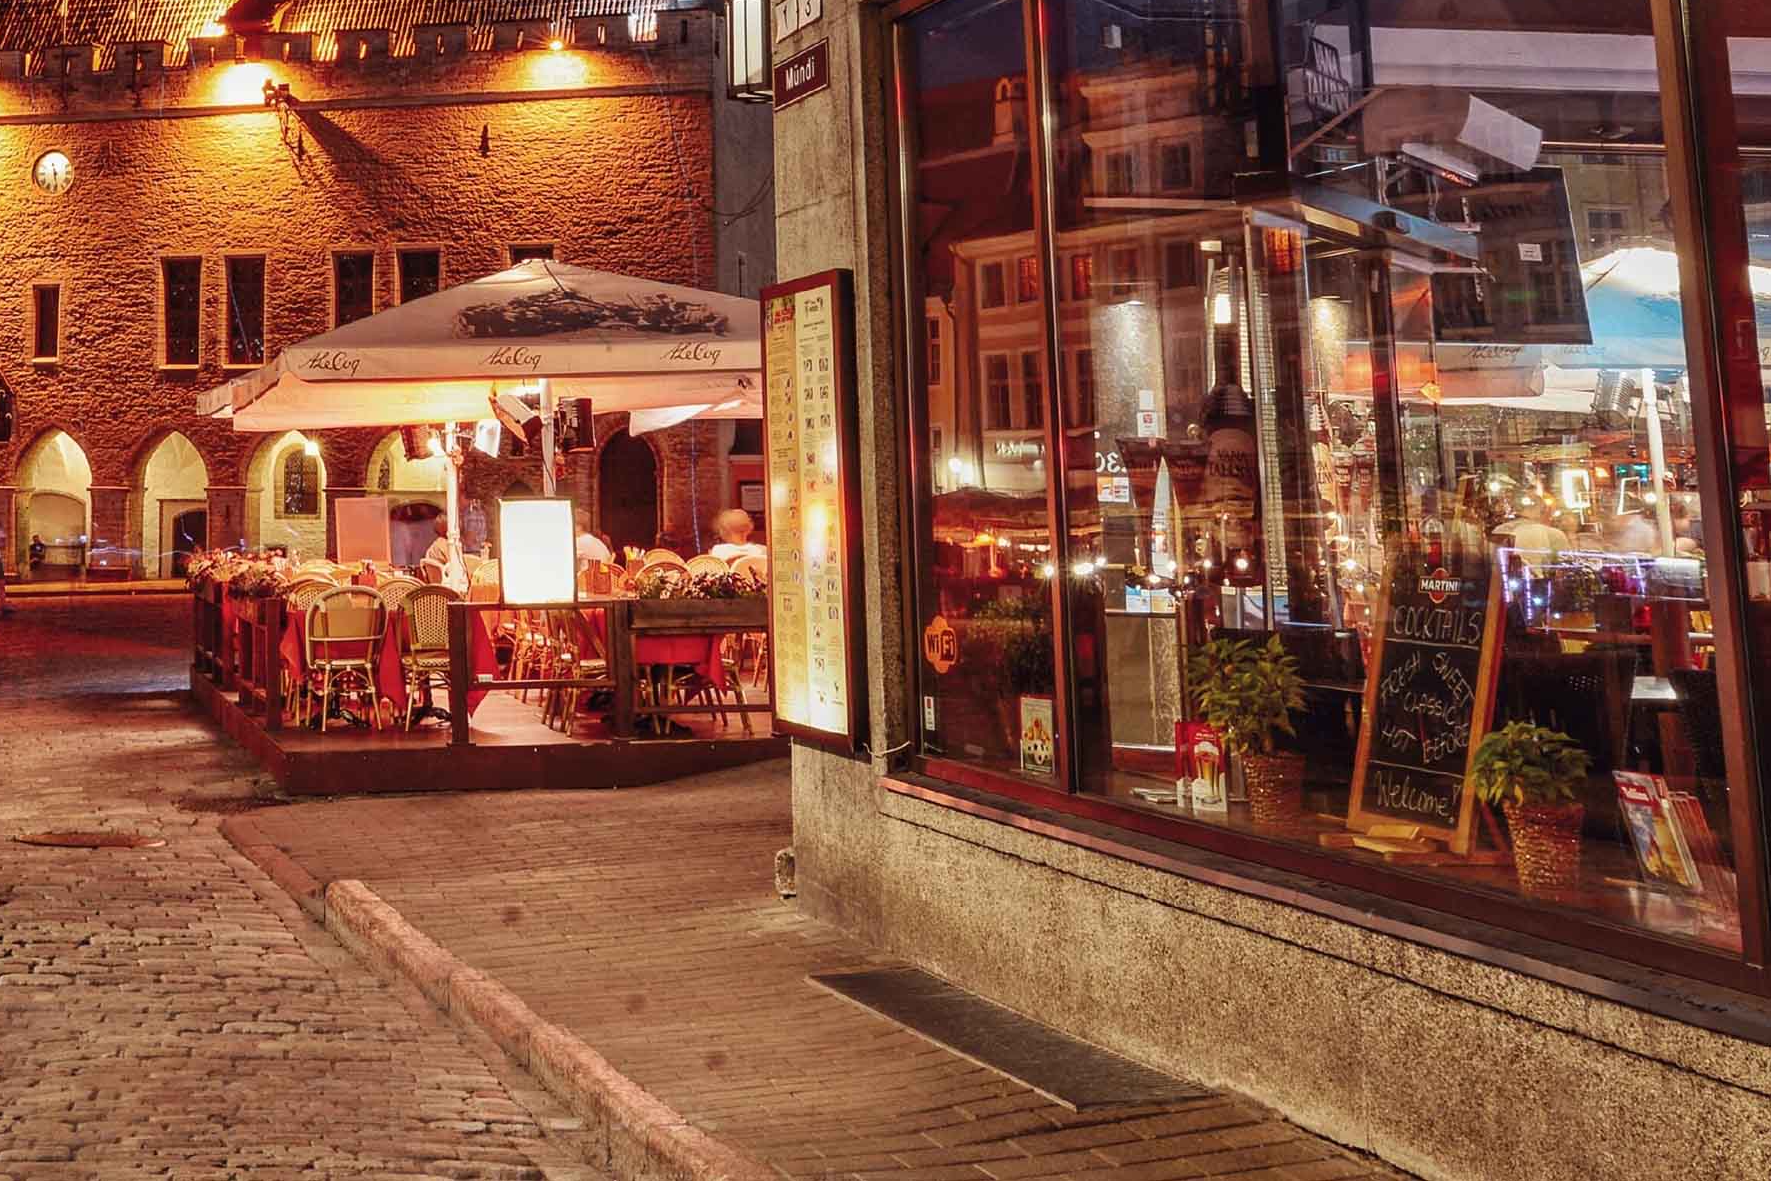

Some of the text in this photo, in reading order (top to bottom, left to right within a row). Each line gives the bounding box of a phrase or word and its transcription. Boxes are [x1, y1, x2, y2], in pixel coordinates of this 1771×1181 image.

[785, 55, 816, 91] Mündi
[1420, 578, 1460, 592] MARTINI
[1393, 605, 1483, 644] COCKTAILS
